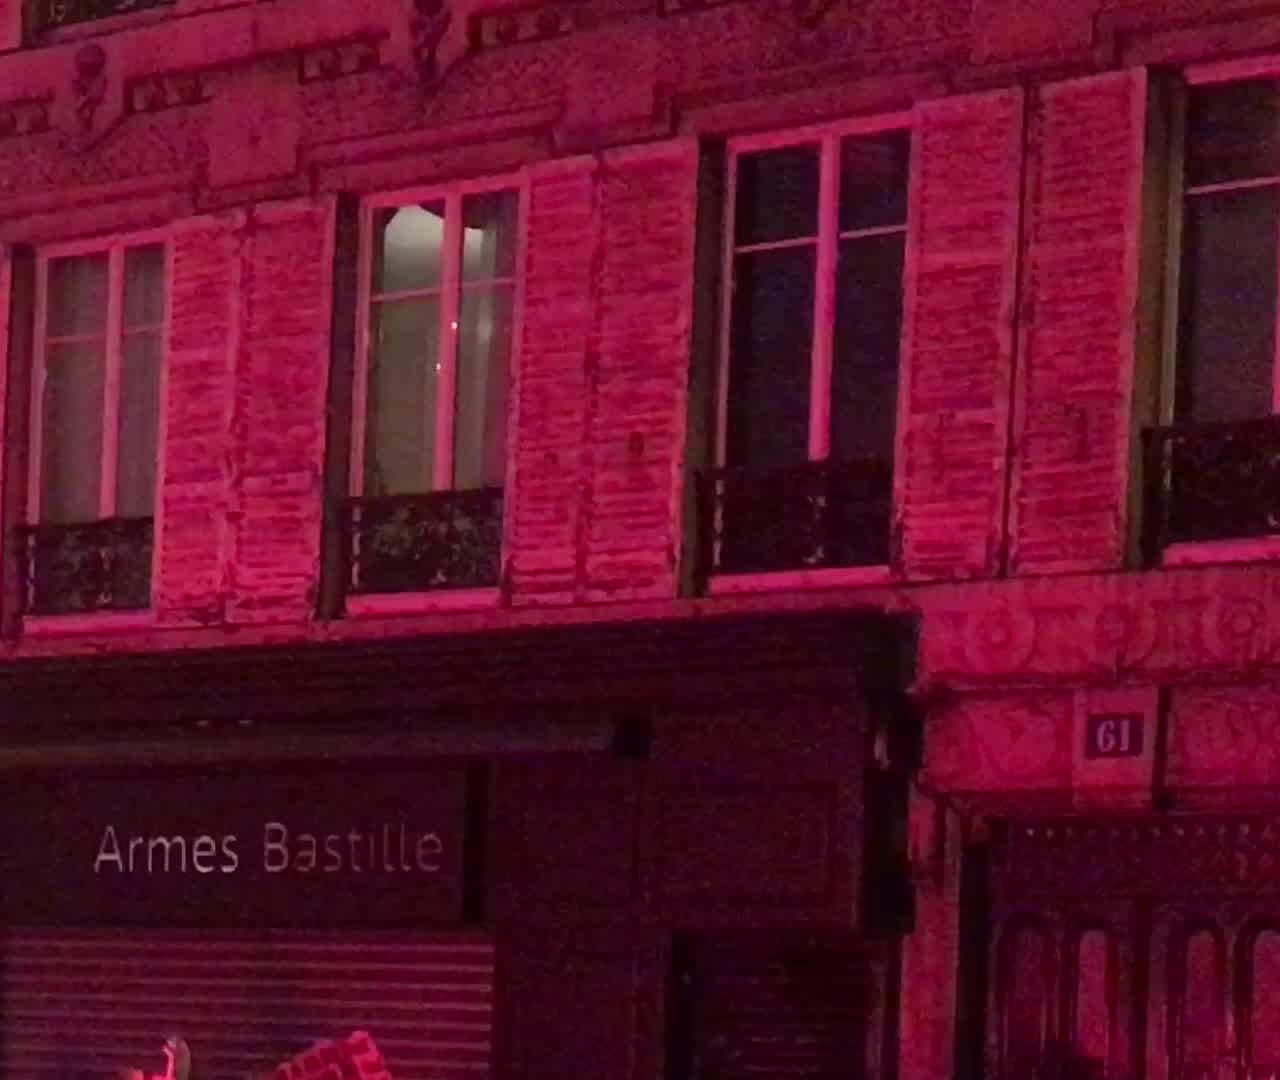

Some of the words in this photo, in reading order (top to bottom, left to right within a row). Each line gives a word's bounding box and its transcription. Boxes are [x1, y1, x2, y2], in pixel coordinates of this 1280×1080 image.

[1096, 719, 1130, 753] 61
[93, 825, 239, 873] Armes
[264, 821, 444, 873] Bastille
